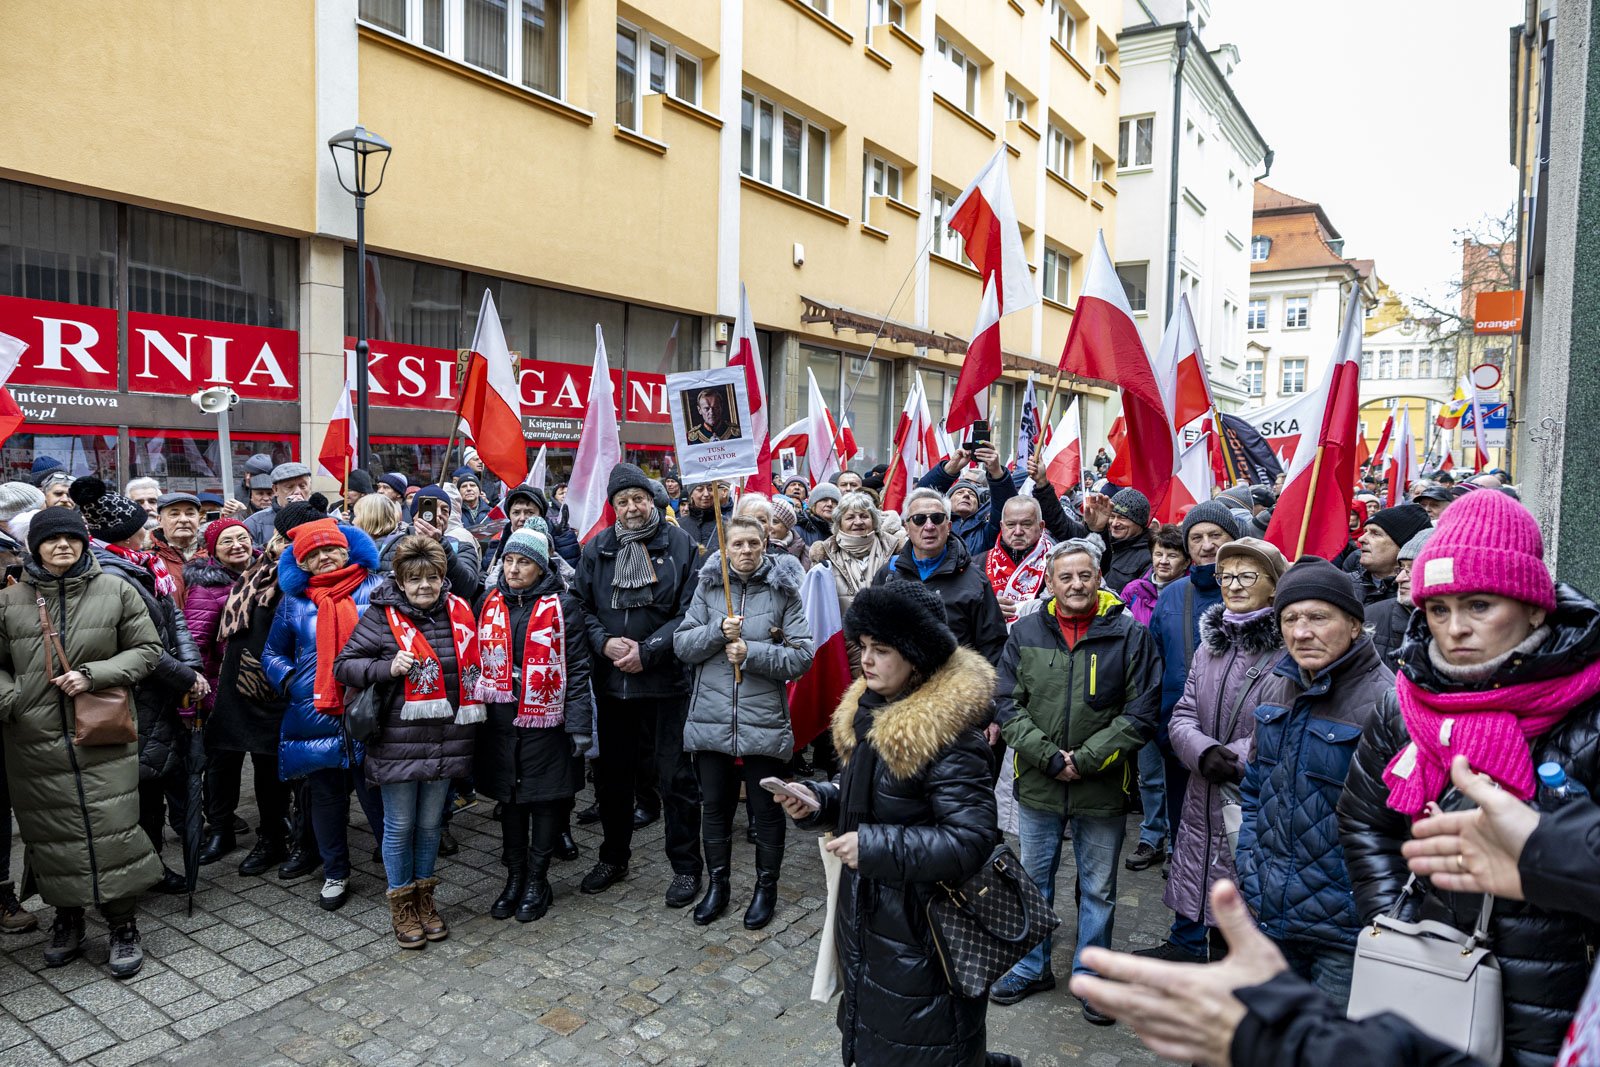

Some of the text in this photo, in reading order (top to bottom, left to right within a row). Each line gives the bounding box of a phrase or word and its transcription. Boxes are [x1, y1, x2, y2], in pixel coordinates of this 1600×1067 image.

[1476, 320, 1517, 329] orange
[16, 315, 293, 388] RNIA
[9, 388, 118, 407] Internetowa
[528, 418, 572, 430] Księgarnia
[707, 446, 725, 454] TUSK
[698, 452, 737, 463] DYKTATOR
